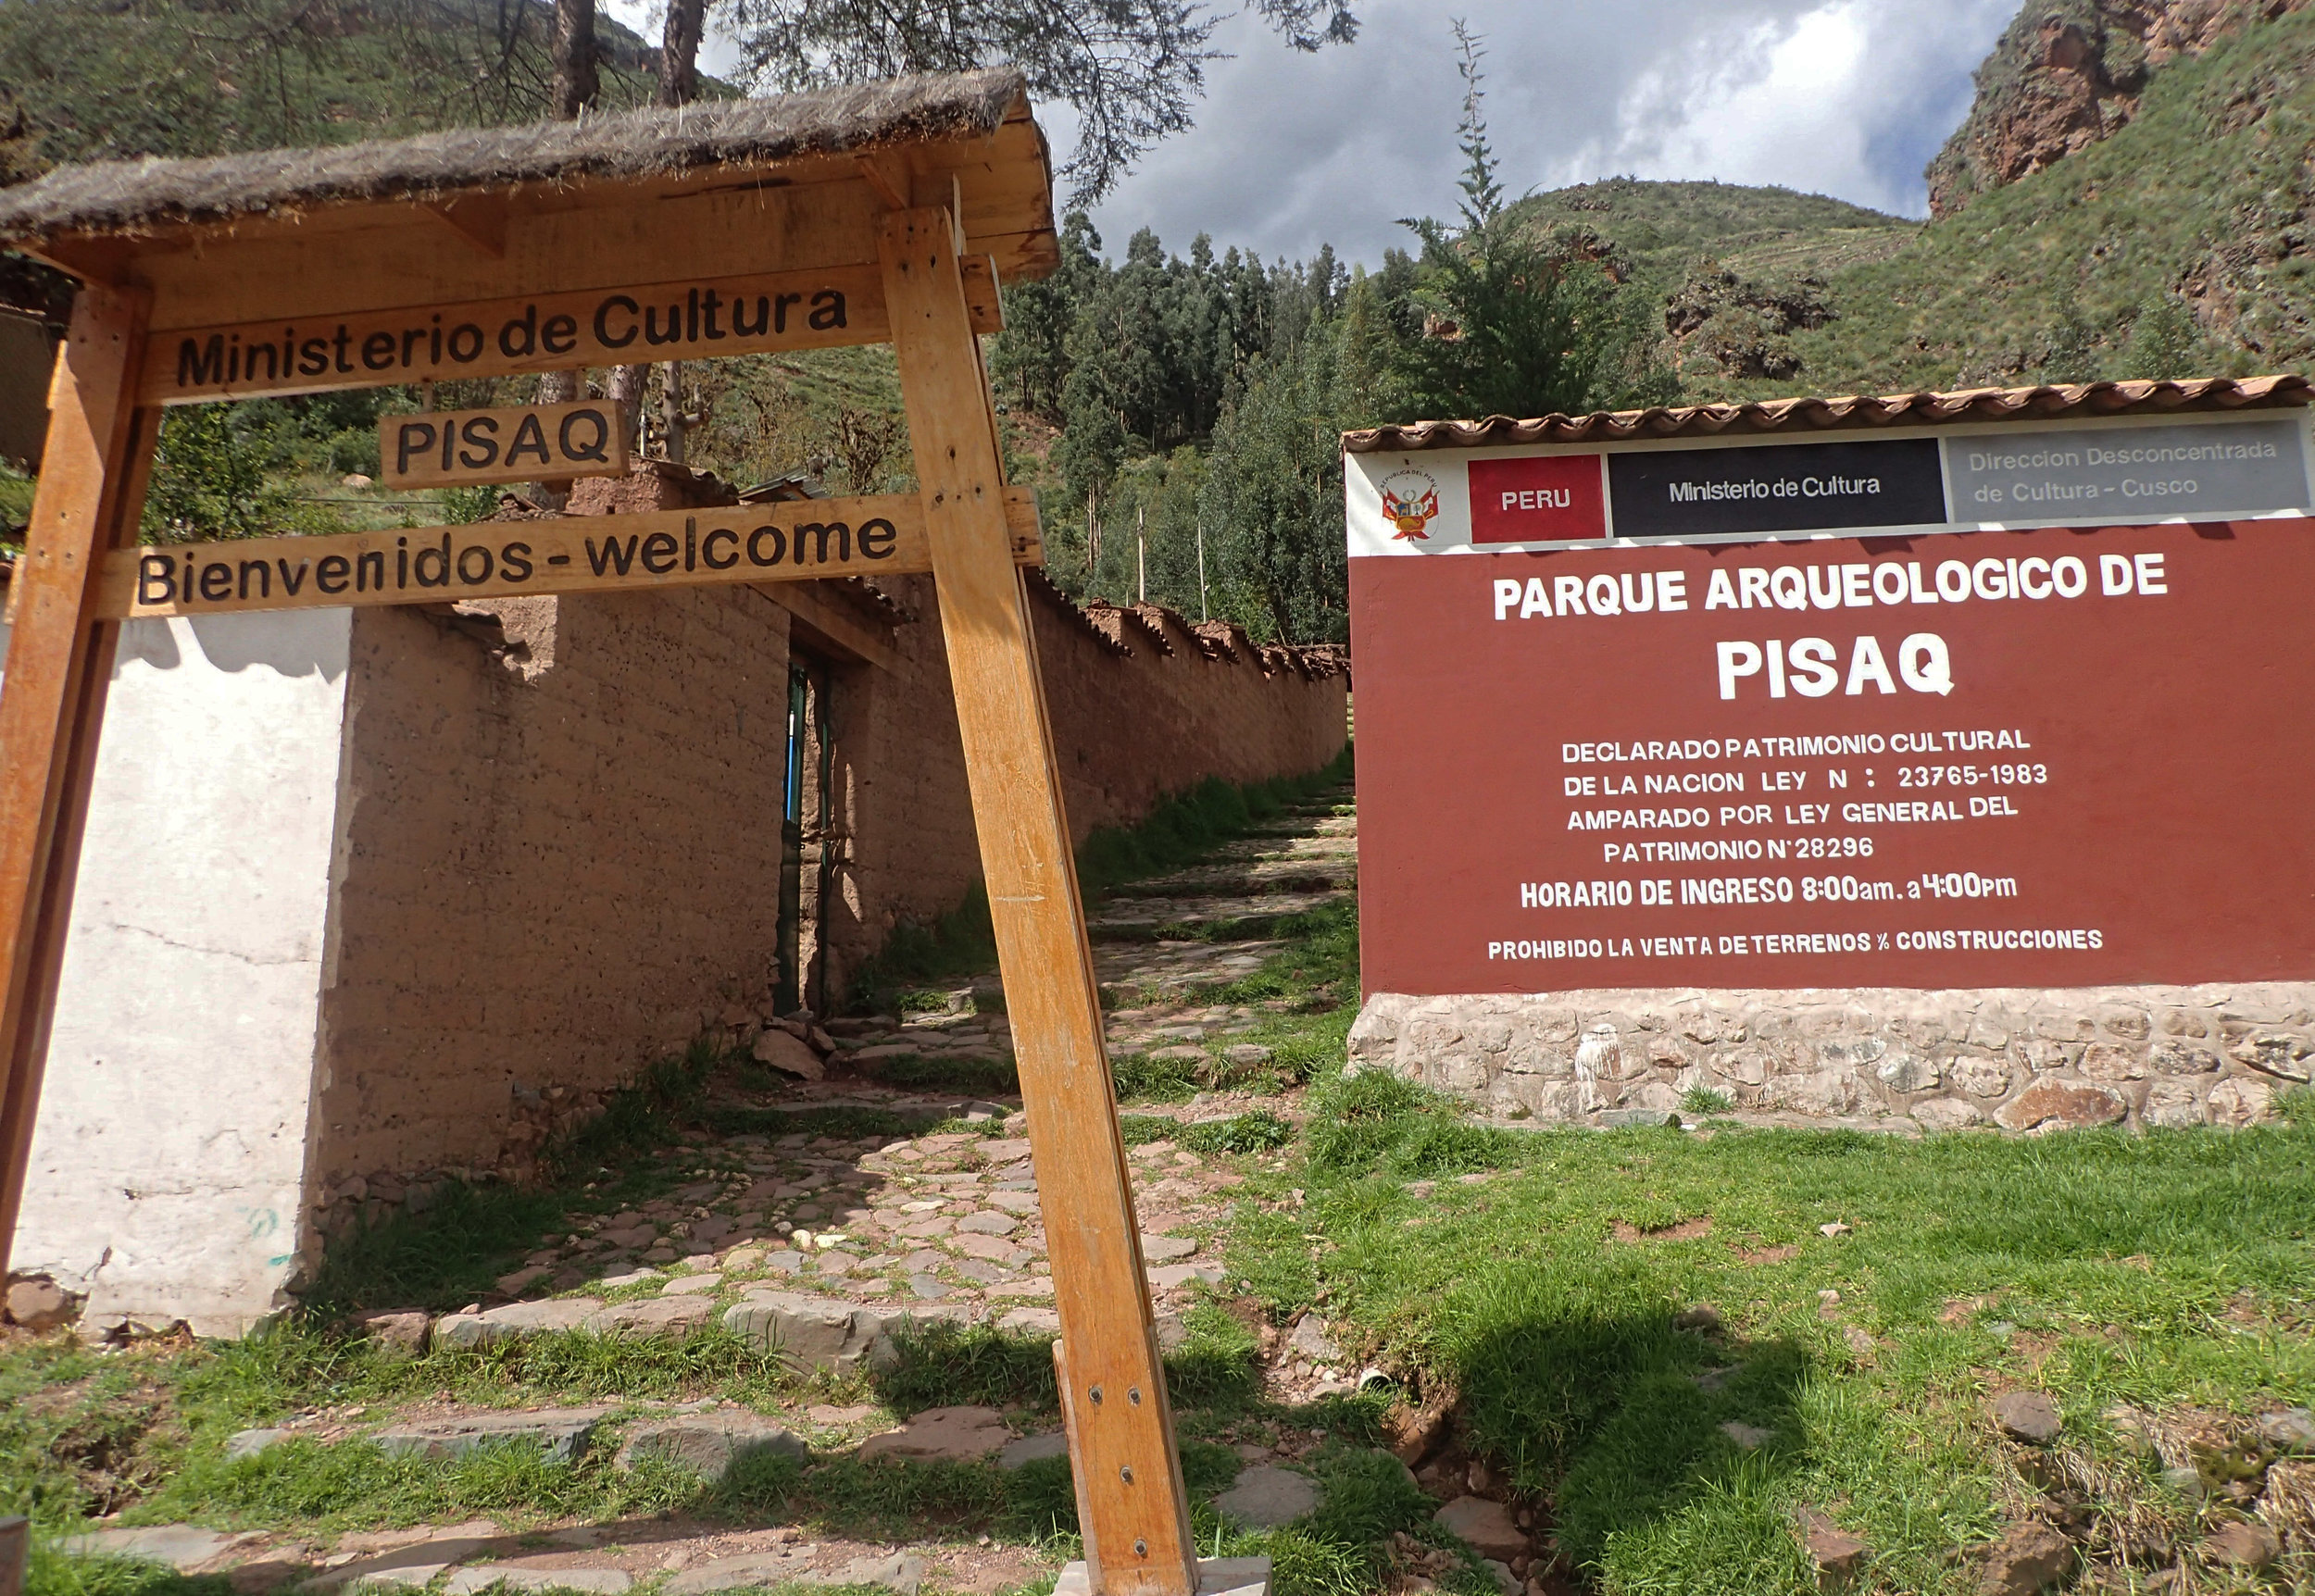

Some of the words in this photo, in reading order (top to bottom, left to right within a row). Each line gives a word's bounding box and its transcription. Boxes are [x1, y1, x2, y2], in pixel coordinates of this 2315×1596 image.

[177, 314, 484, 387] Ministerio
[498, 304, 577, 358] de
[593, 287, 847, 349] Cultura
[397, 408, 609, 475] PISAQ
[1969, 450, 2080, 471] Direccion
[2086, 442, 2277, 466] Desconcentrada
[1501, 488, 1570, 511] PERU
[1669, 479, 1770, 503] Ministerio
[1772, 478, 1798, 498] de
[1802, 475, 1881, 498] Cultura
[1974, 483, 2003, 503] de
[2011, 480, 2099, 503] Cultura
[2121, 478, 2198, 499] Cusco
[138, 531, 534, 605] Bienvenidos
[584, 516, 897, 577] welcome
[1493, 570, 1690, 621] PARQUE
[1704, 555, 2088, 612] ARQUEOLOGICO
[2099, 553, 2169, 596] DE
[1716, 632, 1956, 701] PISAQ
[1562, 739, 1721, 764] DECLARADO
[1724, 733, 1886, 759] PATRIMONIO
[1889, 729, 2032, 754] CULTURAL
[1563, 776, 1597, 797] DE
[1603, 775, 1639, 796] LA
[1644, 772, 1745, 794] NACION
[1761, 770, 1807, 792] LEY
[1897, 763, 2048, 788] 23765-1983
[1567, 806, 1710, 831] AMPARADO
[1720, 804, 1773, 827] POR
[1784, 803, 1831, 825] LEY
[1842, 800, 1965, 824] GENERAL
[1969, 795, 2020, 817] DEL
[1603, 839, 1763, 864] PATRIMONIO
[1520, 879, 1633, 908] HORARIO
[1640, 879, 1674, 905] DE
[1680, 876, 1794, 905] INGRESO
[1488, 939, 1603, 961] PROHIBIDO
[1607, 938, 1634, 957] LA
[1639, 936, 1713, 957] VENTA
[1719, 935, 1749, 955] DE
[1750, 932, 1871, 954] TERRENOS
[1896, 929, 2104, 952] CONSTRUCCIONES
